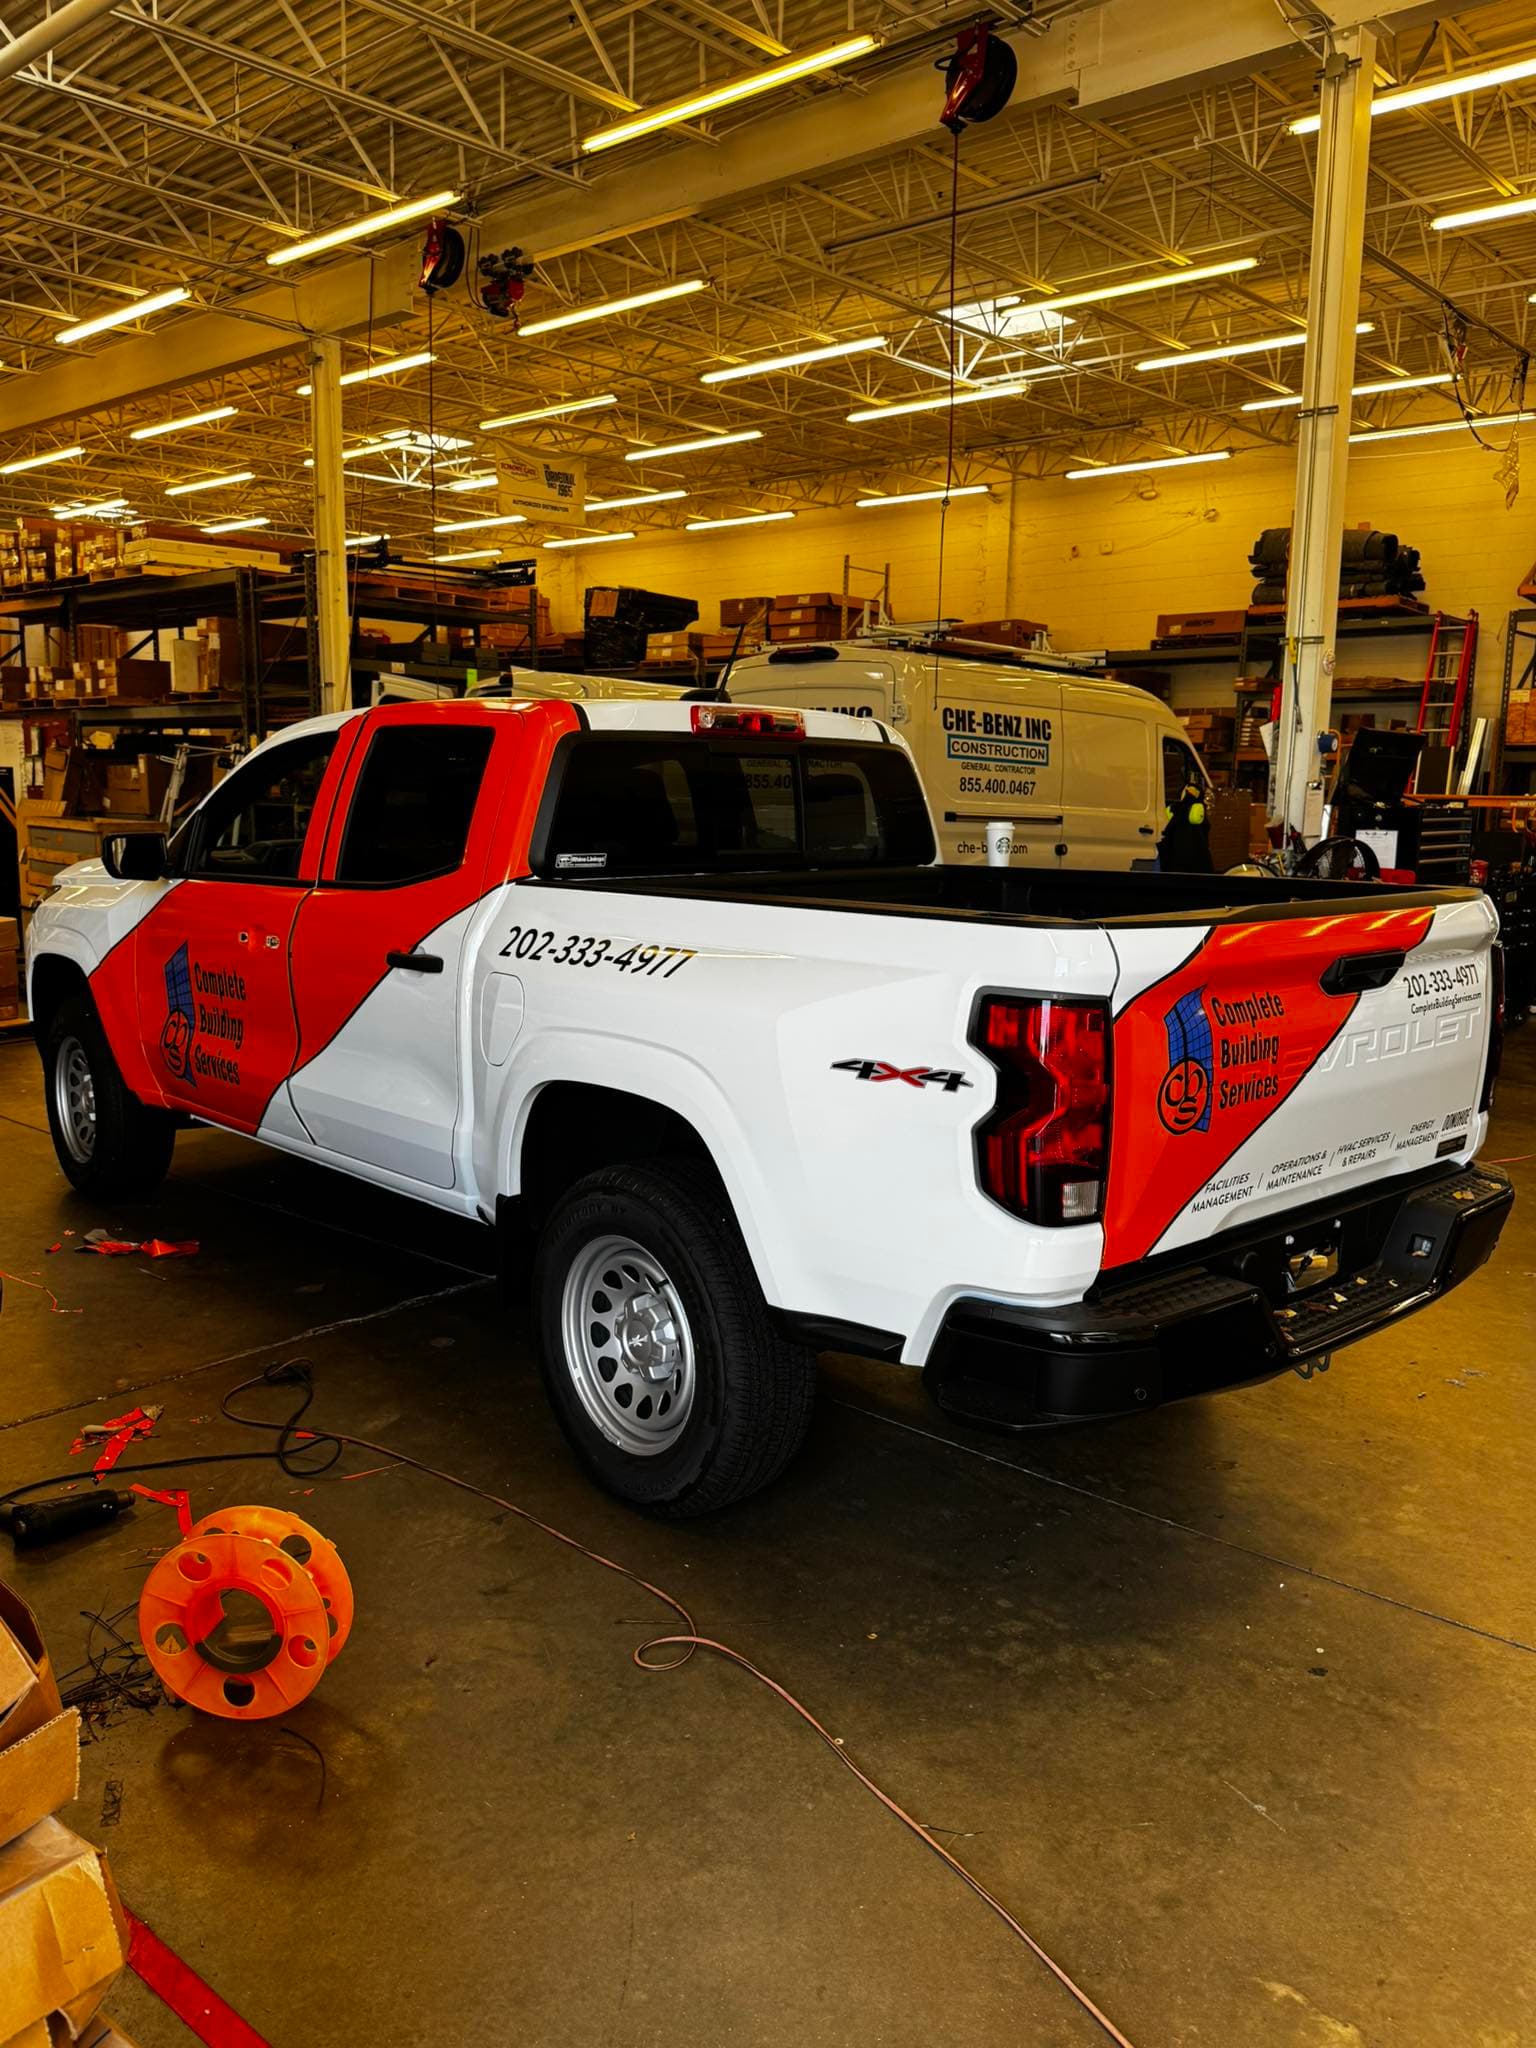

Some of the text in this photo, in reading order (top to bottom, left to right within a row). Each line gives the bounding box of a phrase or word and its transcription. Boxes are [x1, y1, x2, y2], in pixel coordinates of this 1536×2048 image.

[942, 707, 1052, 741] CHE-BENZ INC
[951, 740, 1046, 760] CONSTRUCTION
[961, 761, 1036, 775] GENERAL CONTRACTOR
[959, 776, 1037, 796] 855.400.0467
[499, 926, 698, 978] 202-333-4977
[194, 961, 246, 1004] Complete
[1403, 963, 1479, 998] 202-333-4977
[1211, 992, 1285, 1027] Complete
[1410, 992, 1482, 1016] CompleteBuildingServices.com
[199, 1004, 244, 1050] Building
[1220, 1032, 1279, 1069] Building
[194, 1044, 240, 1086] Services
[1219, 1073, 1279, 1110] Services
[1409, 1119, 1436, 1134] ENERGY
[1337, 1131, 1391, 1155] HVAC SERVICES
[1395, 1130, 1439, 1151] MANAGEMENT
[1271, 1150, 1327, 1175] OPERATIONS &
[1341, 1148, 1376, 1167] & REPAIRS
[1205, 1172, 1251, 1194] FACILITIES
[1266, 1164, 1323, 1191] MAINTENANCE
[1191, 1185, 1254, 1213] MANAGEMENT
